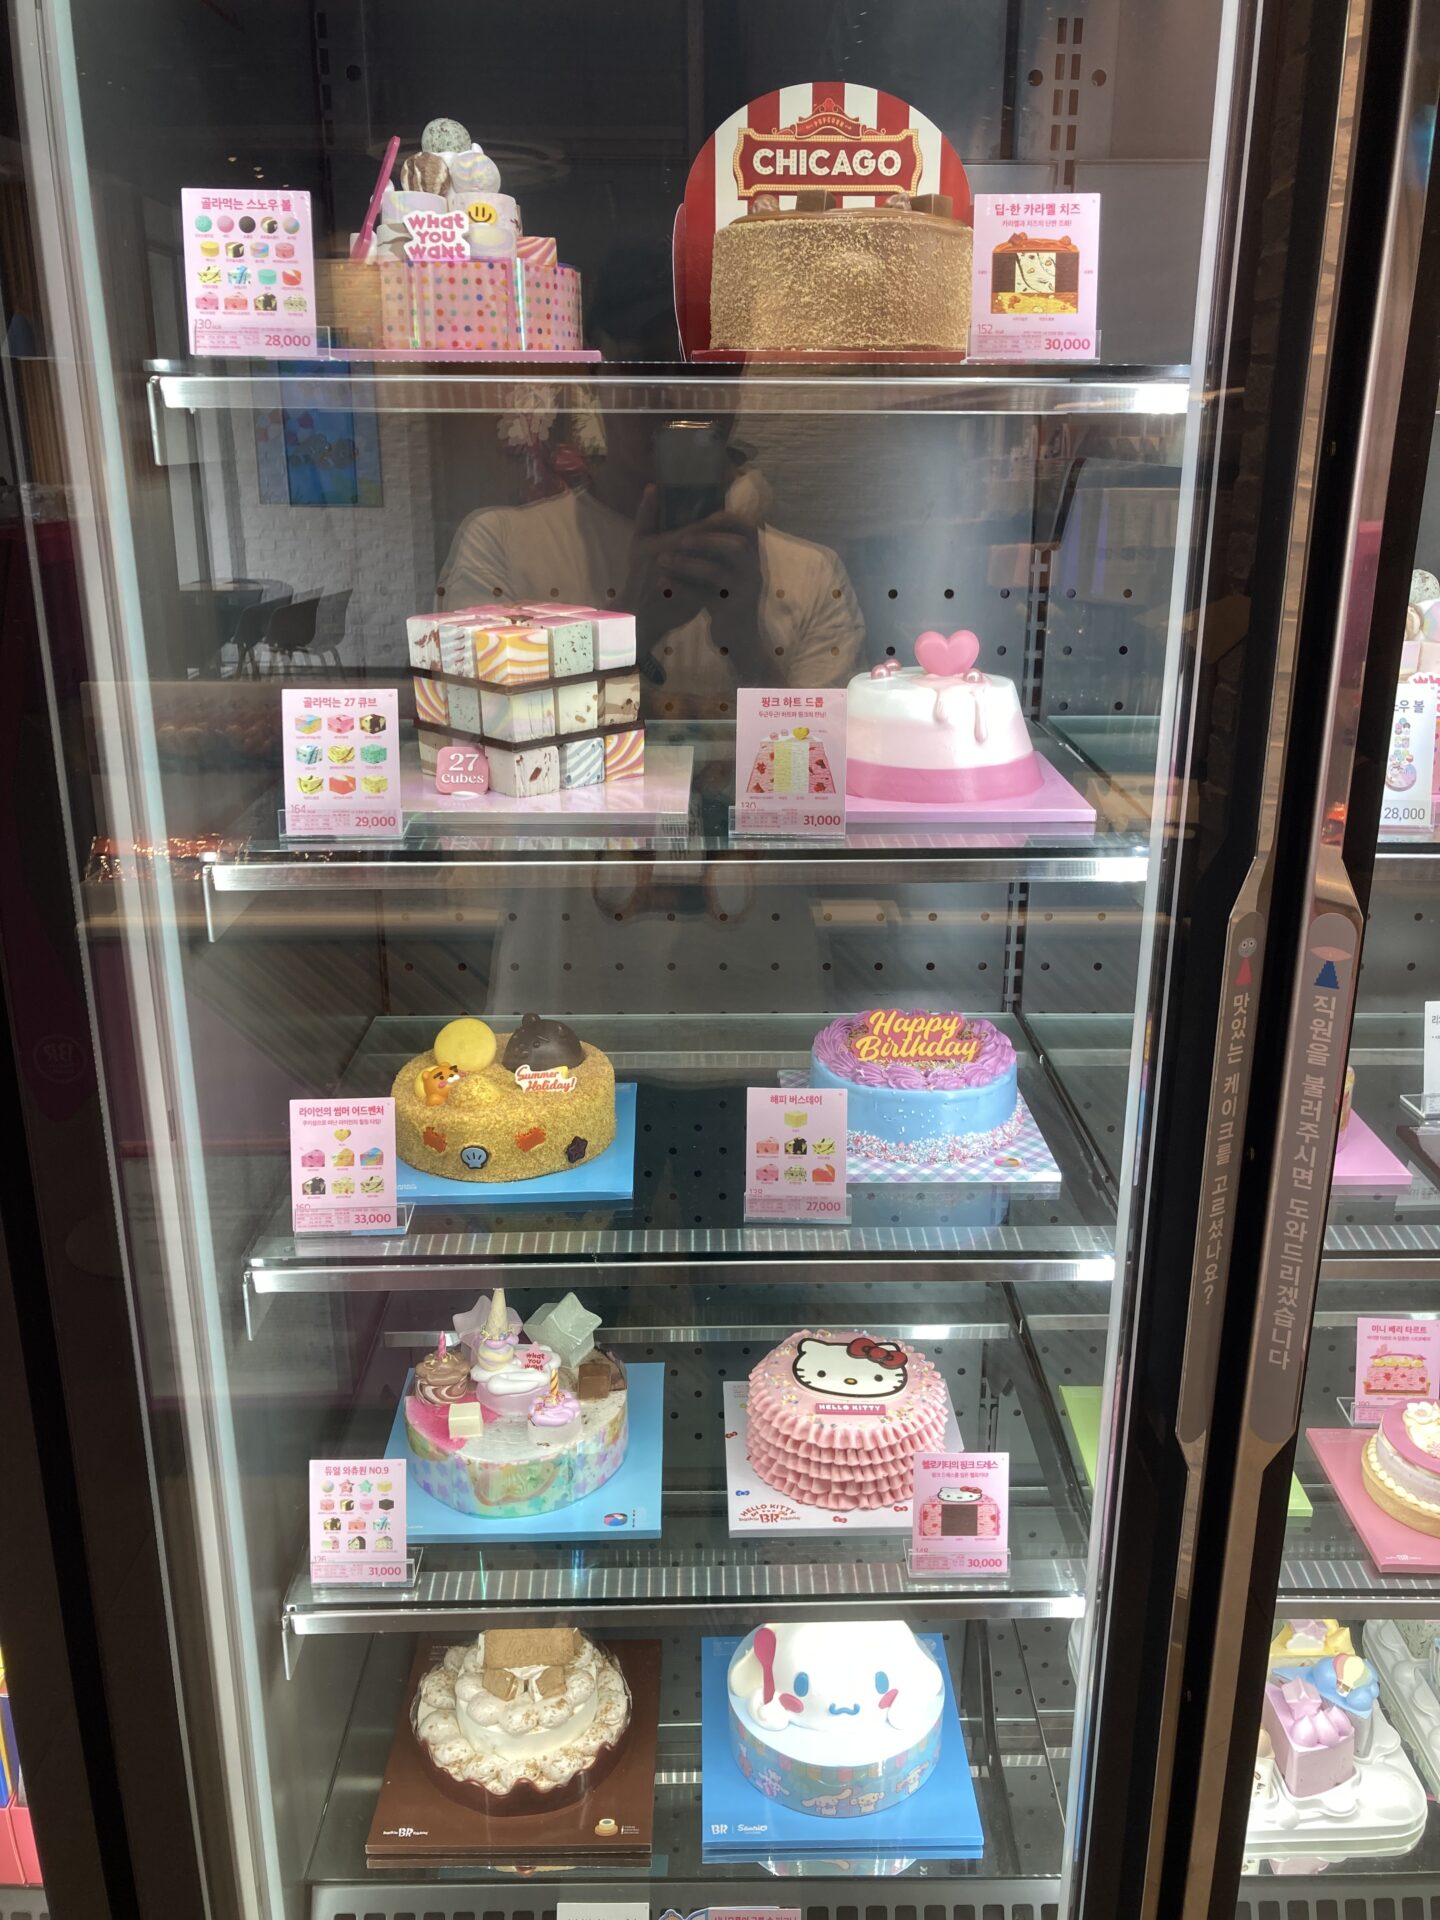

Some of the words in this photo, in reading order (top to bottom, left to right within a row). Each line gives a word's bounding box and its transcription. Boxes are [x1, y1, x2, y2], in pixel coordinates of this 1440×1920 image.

[752, 148, 902, 176] CHICAGO
[201, 197, 244, 210] 골라먹는
[246, 198, 278, 211] 스노우
[994, 202, 1021, 216] 딥-한
[1024, 203, 1056, 216] 카라멜
[1060, 203, 1081, 215] 치즈
[977, 324, 992, 335] 152
[264, 334, 311, 348] 28,000
[1044, 338, 1090, 352] 30,000
[303, 697, 342, 708] 골라먹는
[344, 698, 356, 707] 27
[358, 697, 378, 708] 큐브
[761, 696, 780, 708] 핑크
[783, 696, 802, 708] 하트
[448, 752, 480, 772] 27
[441, 773, 484, 784] Cubes
[291, 804, 306, 814] 164
[1383, 806, 1426, 822] 28,000
[355, 816, 396, 829] 29,000
[803, 815, 841, 828] 31,000
[869, 1010, 961, 1039] Happy
[1226, 992, 1251, 1065] 맛있는
[1305, 994, 1337, 1067] 직원을
[855, 1034, 979, 1062] Birthday
[516, 1066, 560, 1082] Summer
[525, 1078, 576, 1092] Holiday!
[770, 1095, 787, 1105] 해피
[788, 1095, 822, 1106] 버스데이
[299, 1106, 332, 1117] 라이언의
[1215, 1071, 1241, 1167] 케이크를
[1291, 1073, 1327, 1191] 불러주시면
[806, 1201, 841, 1212] 27,000
[354, 1214, 392, 1225] 33,000
[1202, 1174, 1228, 1305] 고르셨나요?
[1268, 1197, 1310, 1371] 도와드리겠습니다
[1371, 1325, 1386, 1334] 미니
[369, 1466, 389, 1475] NO.9
[960, 1460, 974, 1470] 핑크
[740, 1504, 768, 1517] HELLO
[770, 1504, 796, 1514] KITTY
[760, 1514, 780, 1523] BR
[967, 1558, 1002, 1569] 30,000
[368, 1566, 402, 1576] 31,000
[398, 1828, 414, 1837] BR
[711, 1824, 728, 1835] BR
